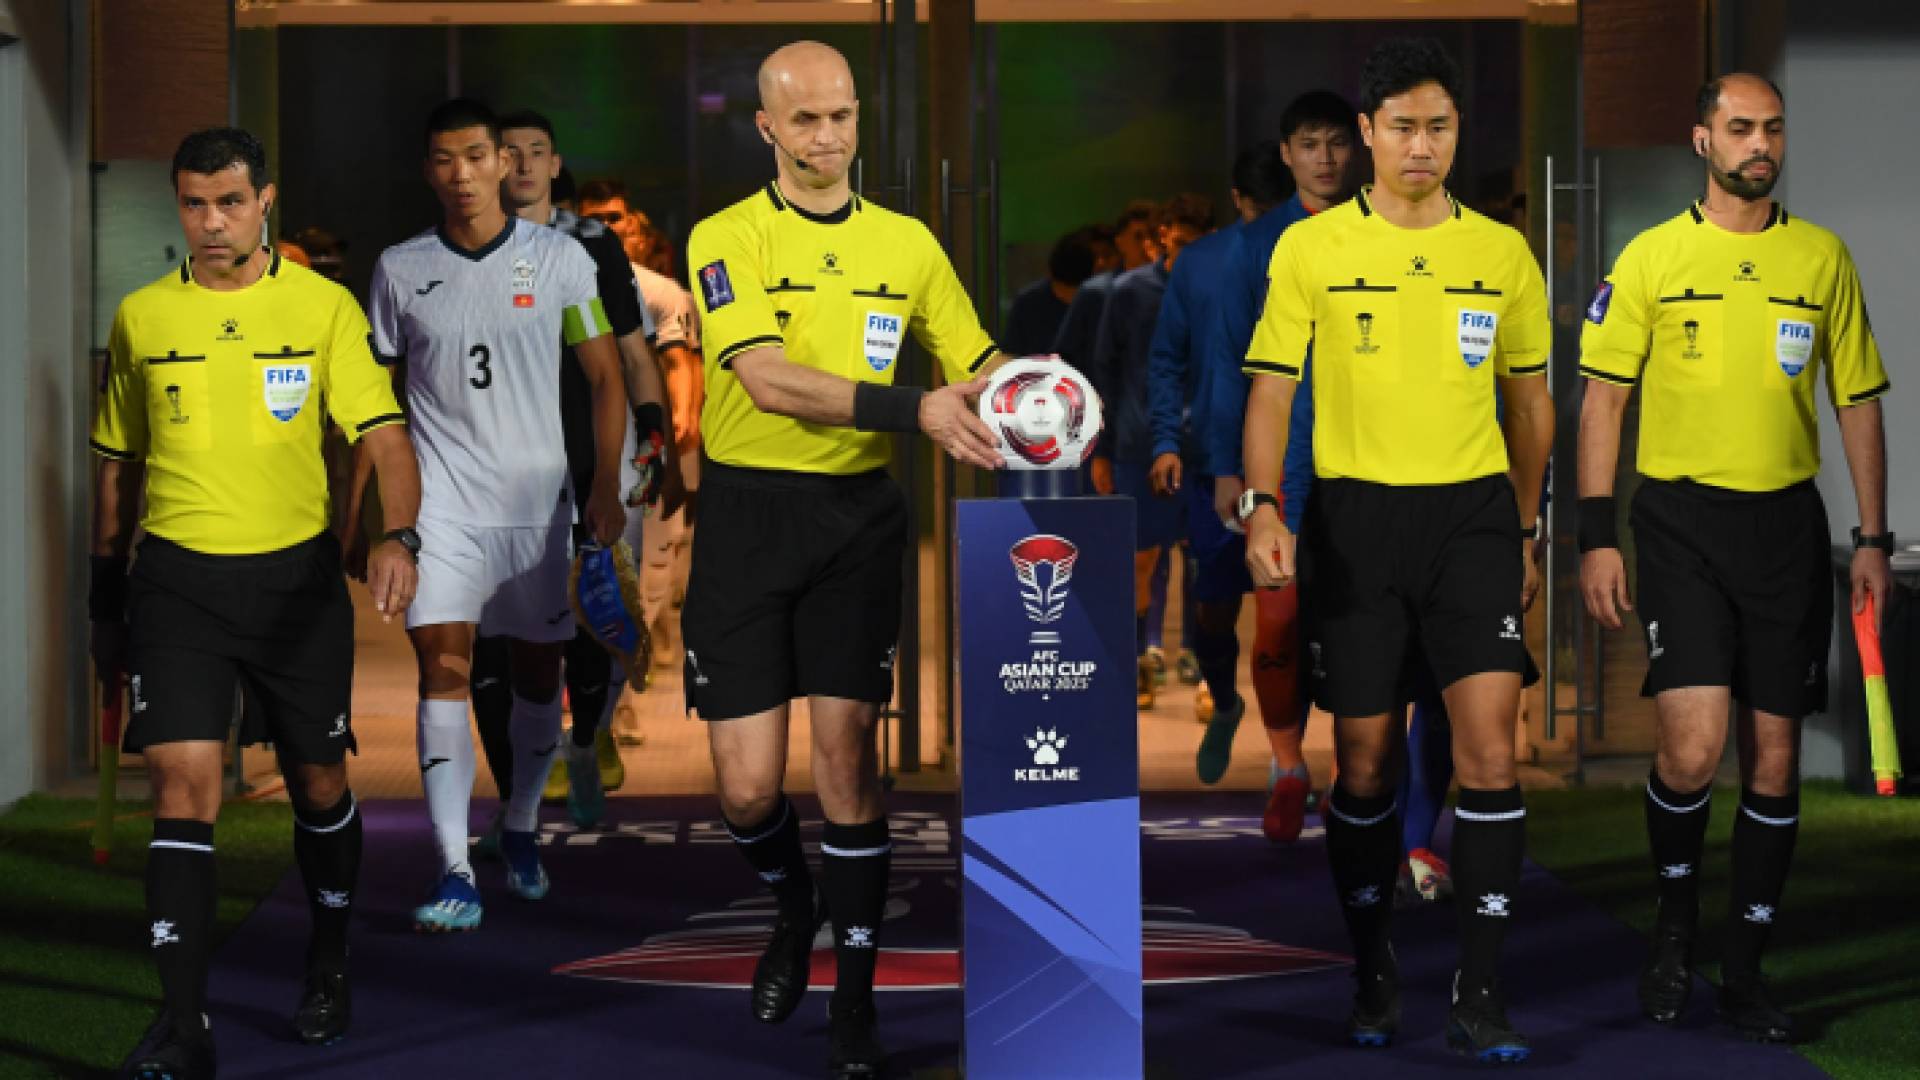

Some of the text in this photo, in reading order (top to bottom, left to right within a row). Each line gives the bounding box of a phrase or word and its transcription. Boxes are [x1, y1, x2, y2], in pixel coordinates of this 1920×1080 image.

[868, 315, 897, 332] FIFA
[1461, 312, 1493, 329] FIFA
[1780, 323, 1810, 339] FIFA
[469, 343, 492, 389] 3
[266, 368, 306, 384] FIFA
[1032, 650, 1059, 662] AFC
[999, 661, 1096, 677] ASIAN CUP
[1003, 678, 1051, 693] QATAR
[1014, 767, 1080, 781] KELME
